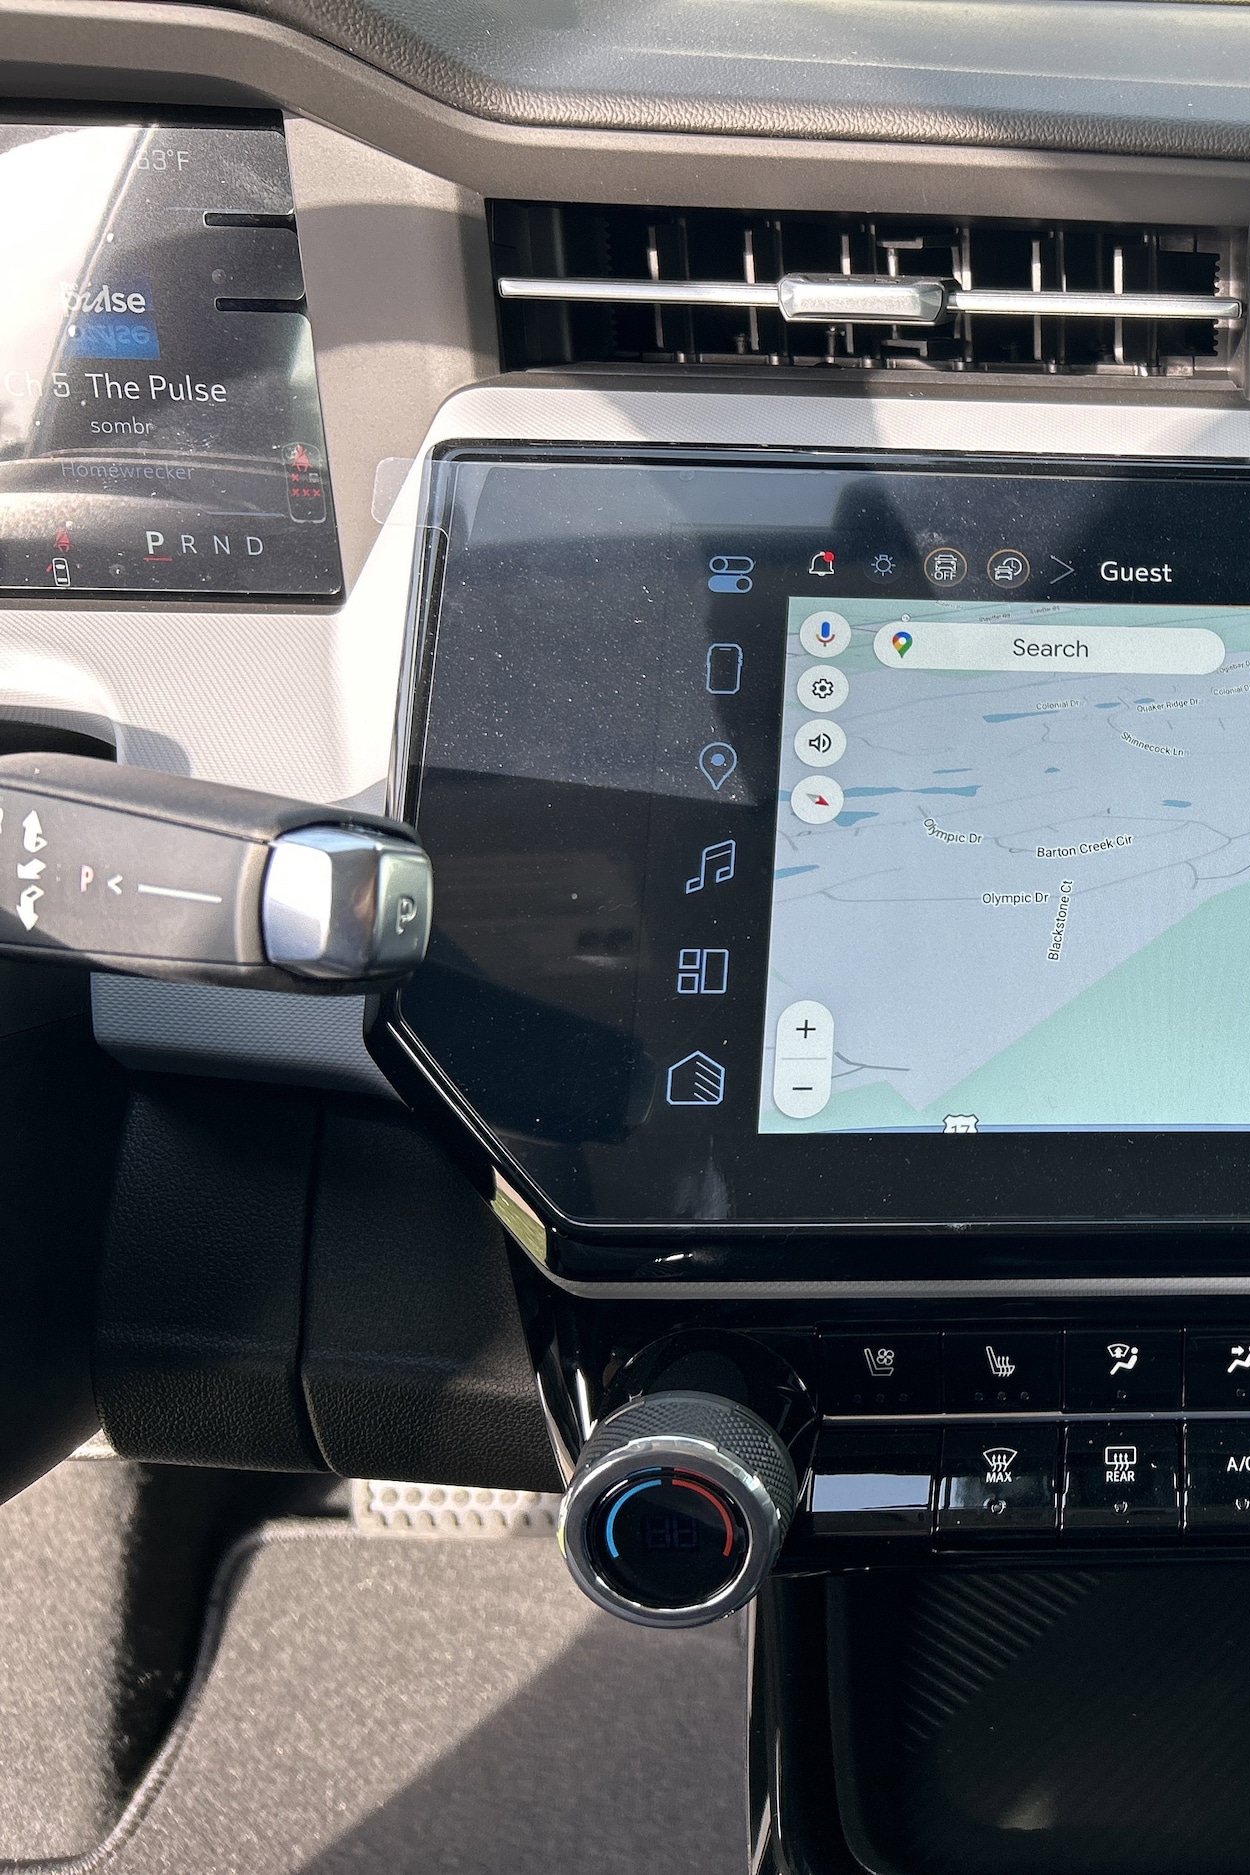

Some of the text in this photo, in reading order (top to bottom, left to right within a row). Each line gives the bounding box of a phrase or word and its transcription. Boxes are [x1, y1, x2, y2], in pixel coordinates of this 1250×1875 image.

[84, 372, 140, 400] The
[148, 374, 227, 402] Pulse
[90, 416, 151, 435] sombr
[60, 461, 195, 481] Homewrecker
[145, 530, 264, 556] P R N D
[934, 571, 957, 581] OFF
[1099, 561, 1172, 584] Guest
[1012, 638, 1090, 659] Search
[1213, 687, 1243, 696] Colonial
[1036, 699, 1080, 711] Colonial Dr
[1136, 697, 1200, 713] Quaker Ridge Dr
[1121, 731, 1184, 757] Shinnecock Ln
[924, 818, 982, 844] Olympic Dr
[1036, 835, 1133, 859] Barton Creek Cir
[982, 892, 1049, 907] Olympic Dr
[1048, 880, 1074, 961] Blackstone Ct
[986, 1472, 1012, 1483] MAX
[1105, 1471, 1136, 1483] REAR
